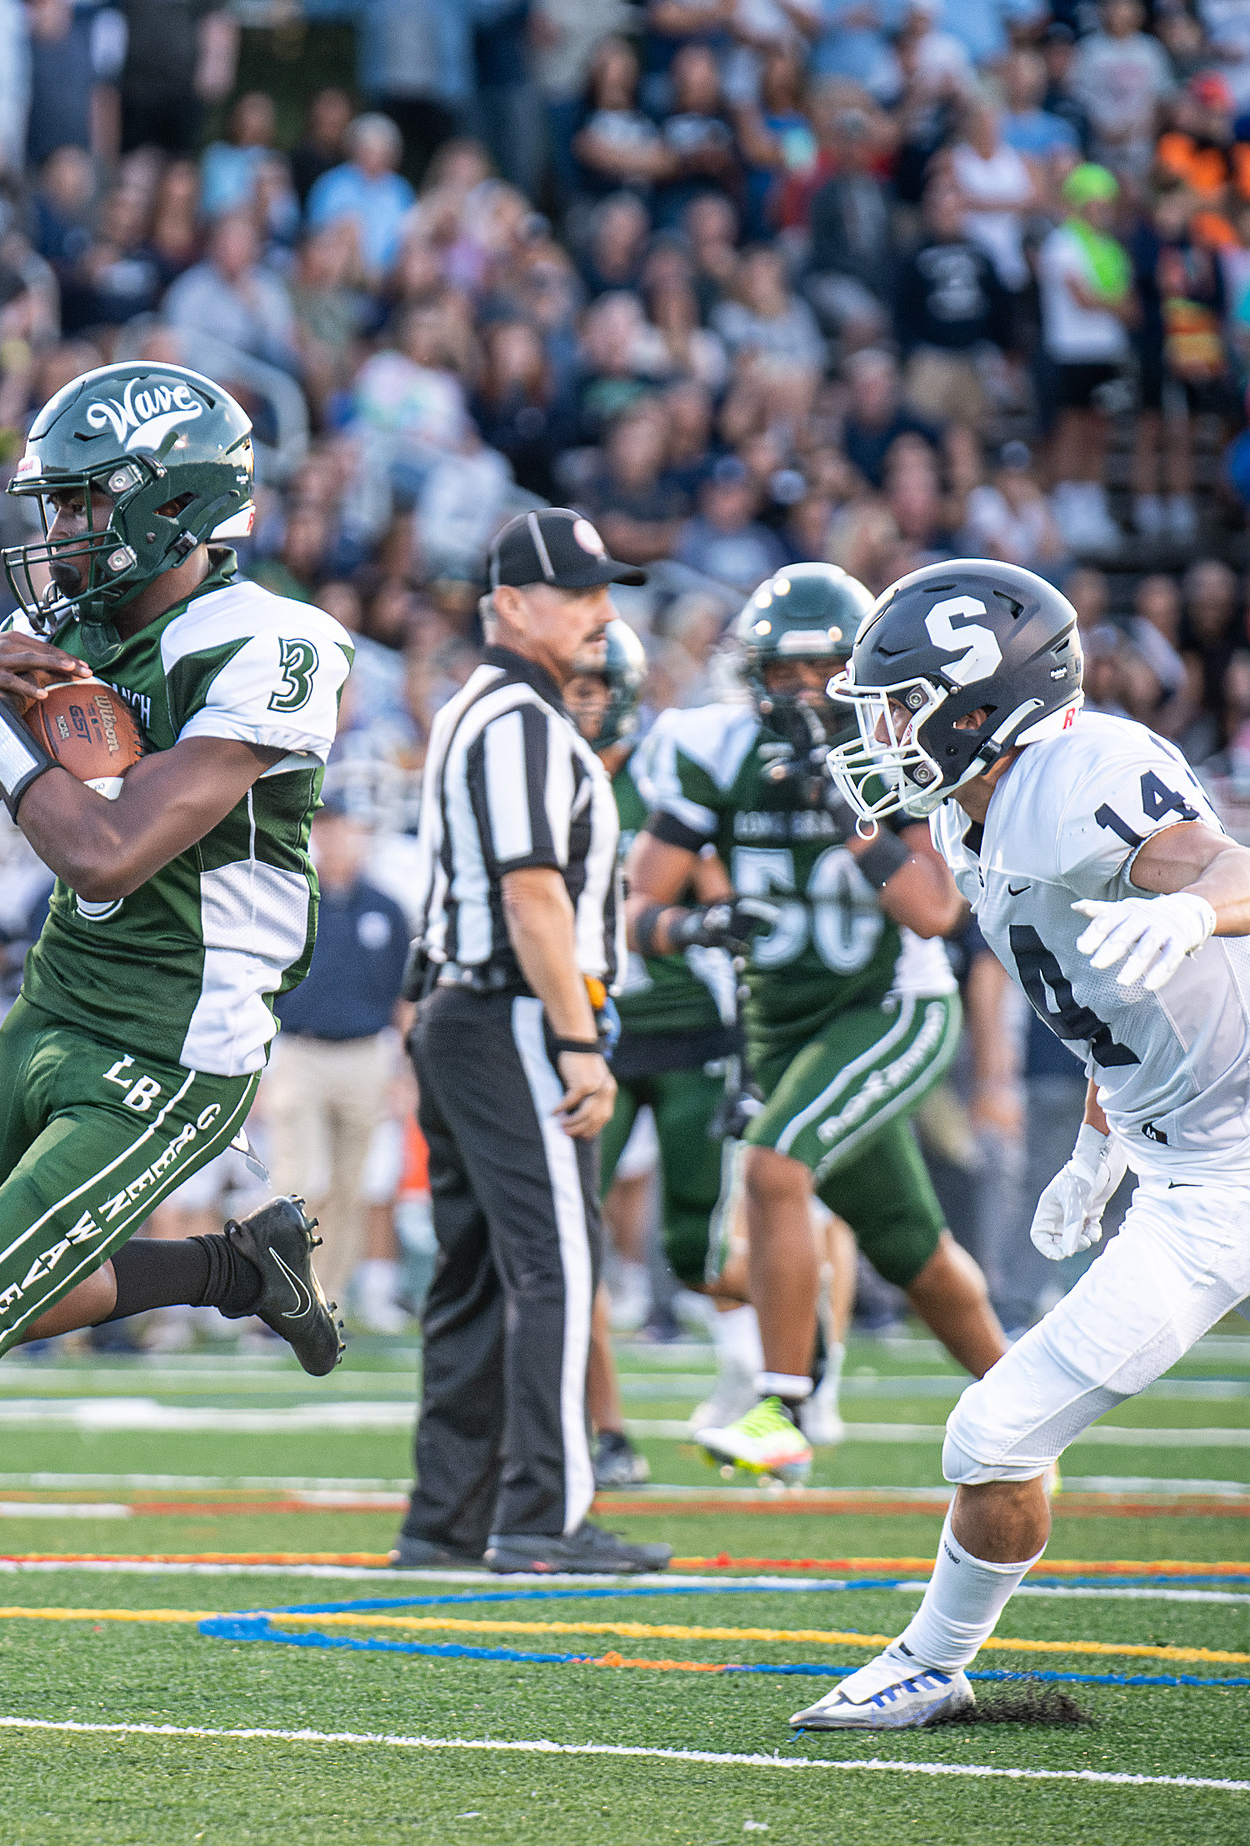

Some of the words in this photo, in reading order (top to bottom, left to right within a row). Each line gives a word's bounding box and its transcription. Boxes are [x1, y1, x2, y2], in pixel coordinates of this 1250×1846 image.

[87, 377, 192, 444] Wave
[266, 635, 321, 714] 3
[924, 594, 1004, 687] S
[68, 704, 93, 744] GST
[93, 694, 120, 753] Wilson
[1093, 769, 1200, 850] 14
[730, 844, 886, 976] 50
[102, 1053, 162, 1112] LB
[97, 1103, 222, 1223] GREEN
